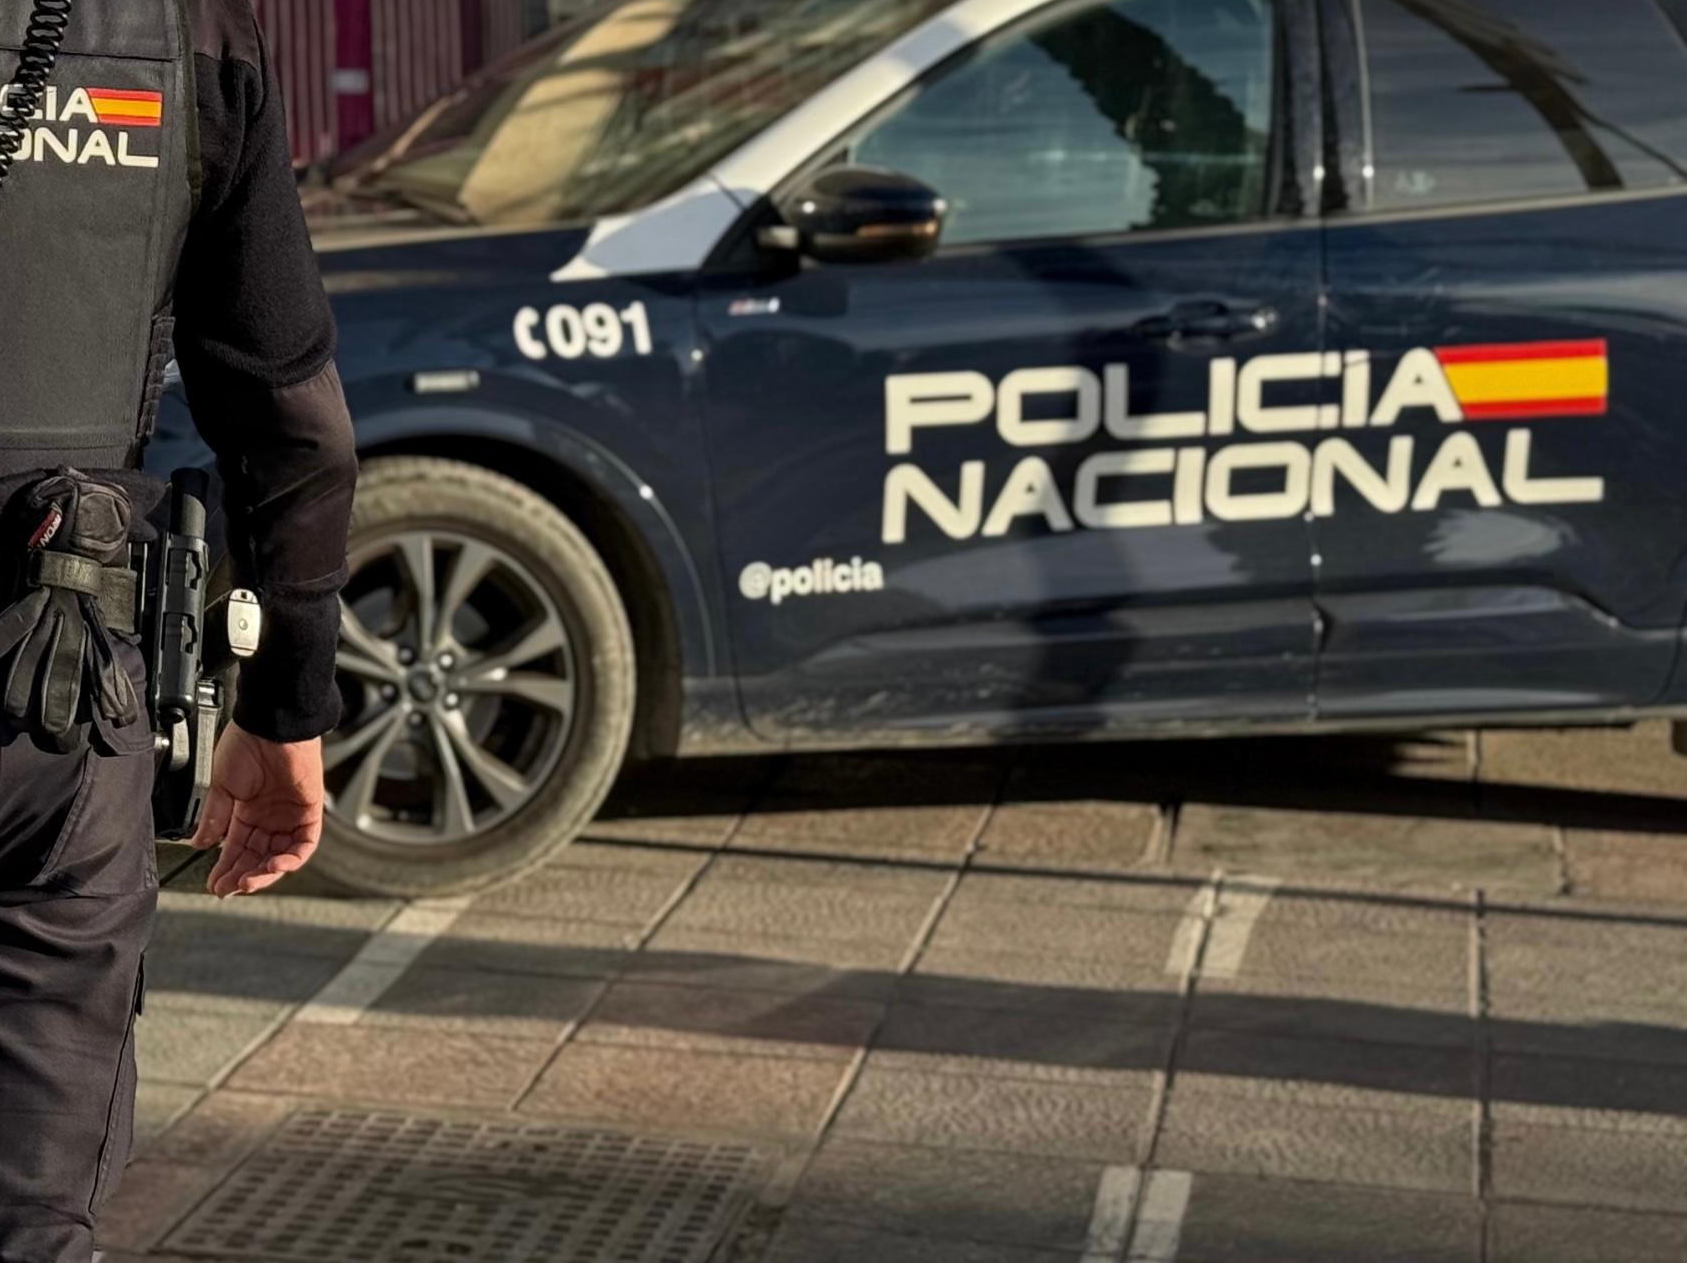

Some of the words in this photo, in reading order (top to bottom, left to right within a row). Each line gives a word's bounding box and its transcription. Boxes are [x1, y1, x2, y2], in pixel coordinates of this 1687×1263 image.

[545, 300, 653, 360] 091
[882, 427, 1605, 544] NACIONAL
[738, 555, 885, 605] @policia
